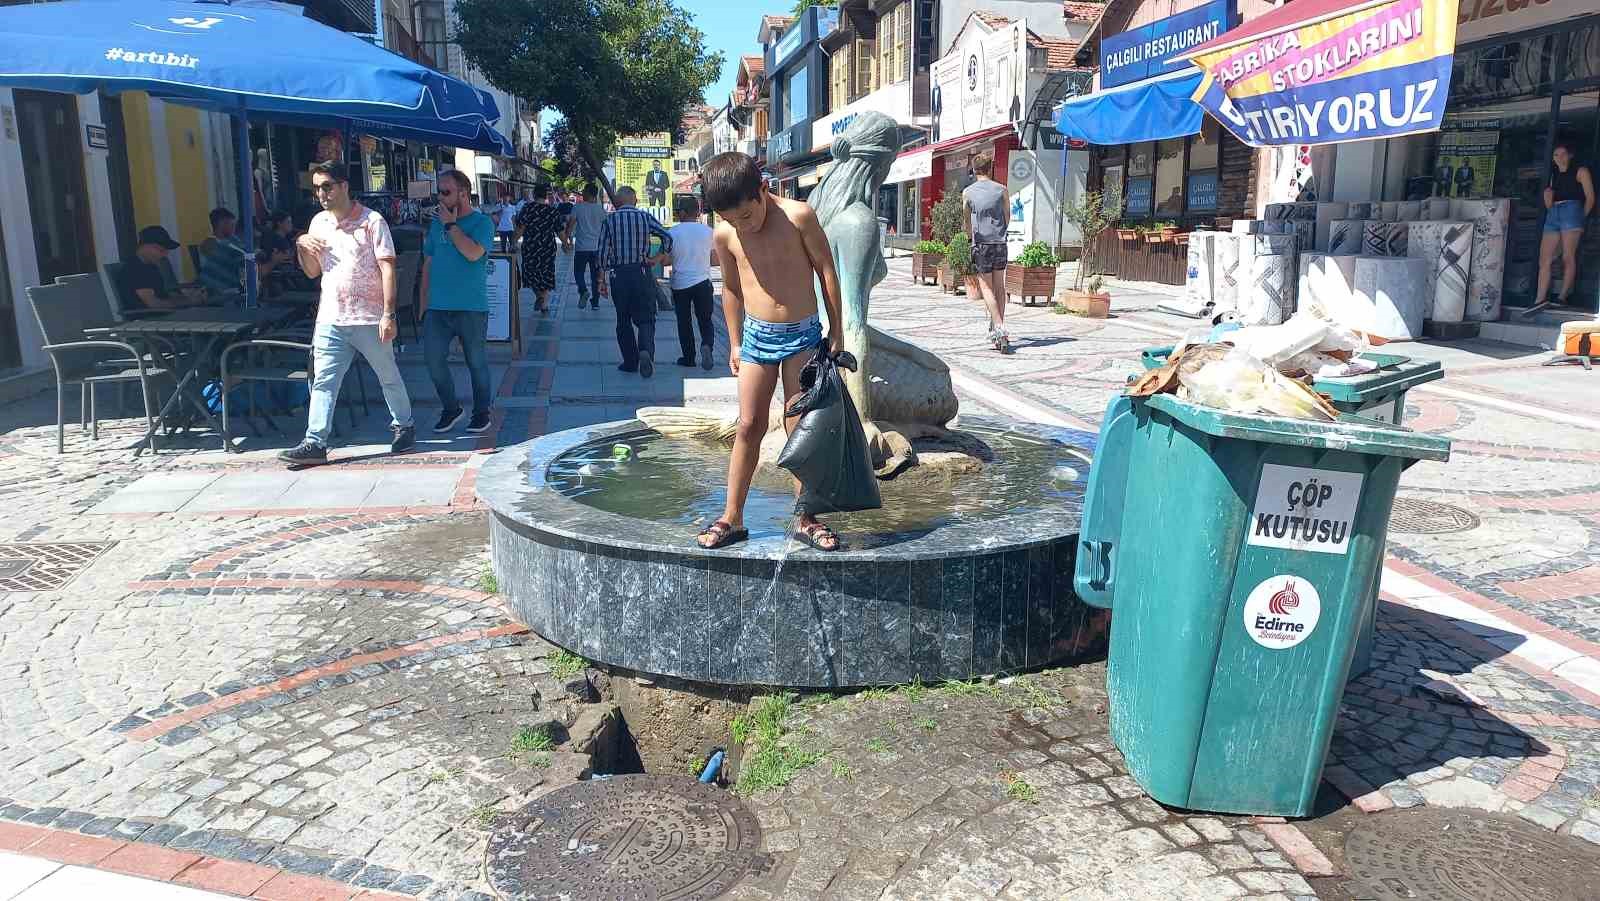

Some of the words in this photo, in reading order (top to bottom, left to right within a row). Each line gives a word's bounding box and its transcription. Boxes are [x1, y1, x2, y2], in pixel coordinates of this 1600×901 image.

[104, 47, 200, 68] #artıbir
[1106, 50, 1142, 74] ÇALGILI
[1144, 20, 1220, 59] RESTAURANT
[1272, 8, 1424, 92] STOKLARINI
[1219, 79, 1438, 140] TİRİYORUZ
[1287, 478, 1333, 511] ÇÖP
[1255, 513, 1347, 545] KUTUSU
[1255, 616, 1305, 633] Edirne
